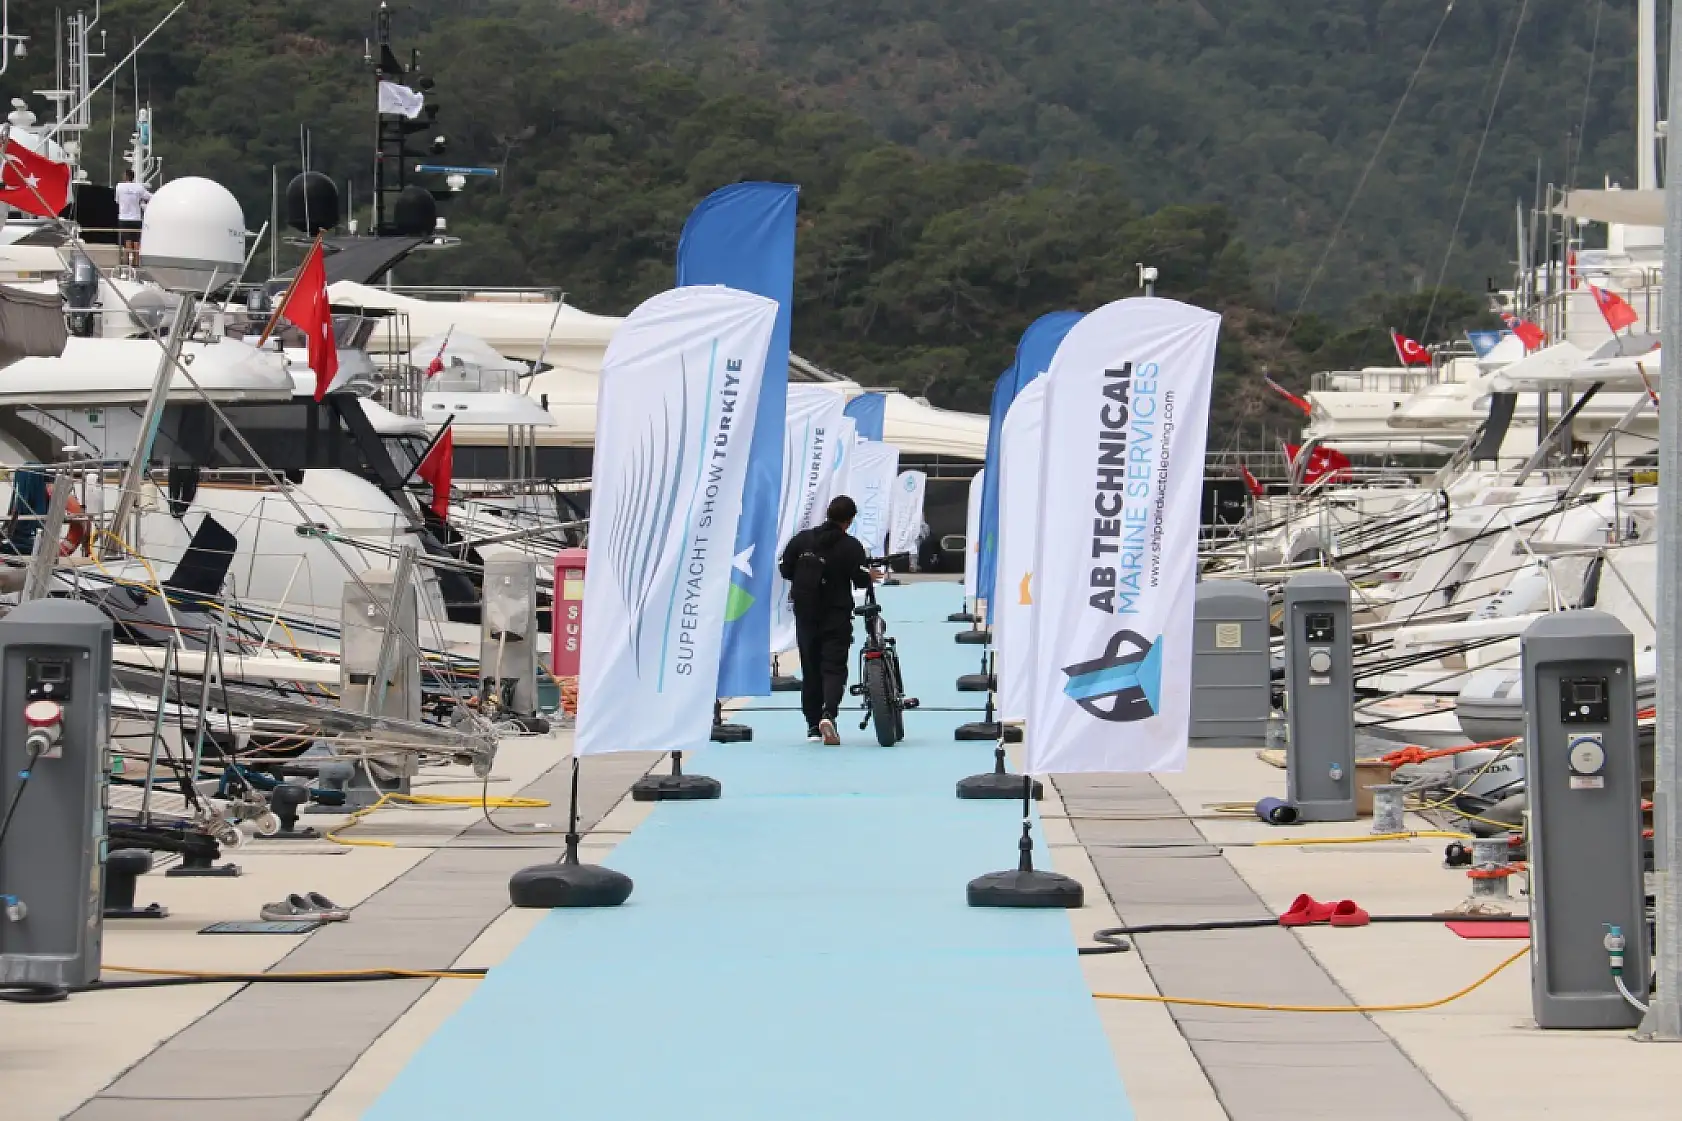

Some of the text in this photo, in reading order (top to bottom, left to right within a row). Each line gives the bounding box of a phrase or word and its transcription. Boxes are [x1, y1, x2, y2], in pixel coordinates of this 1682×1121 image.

[677, 358, 743, 676] SUPERYACHT SHOW TÜRKİYE
[1089, 360, 1132, 615] AB TECHNICAL
[1117, 362, 1159, 615] MARINE SERVICES
[1150, 390, 1175, 587] www.shipairductcleaning.com
